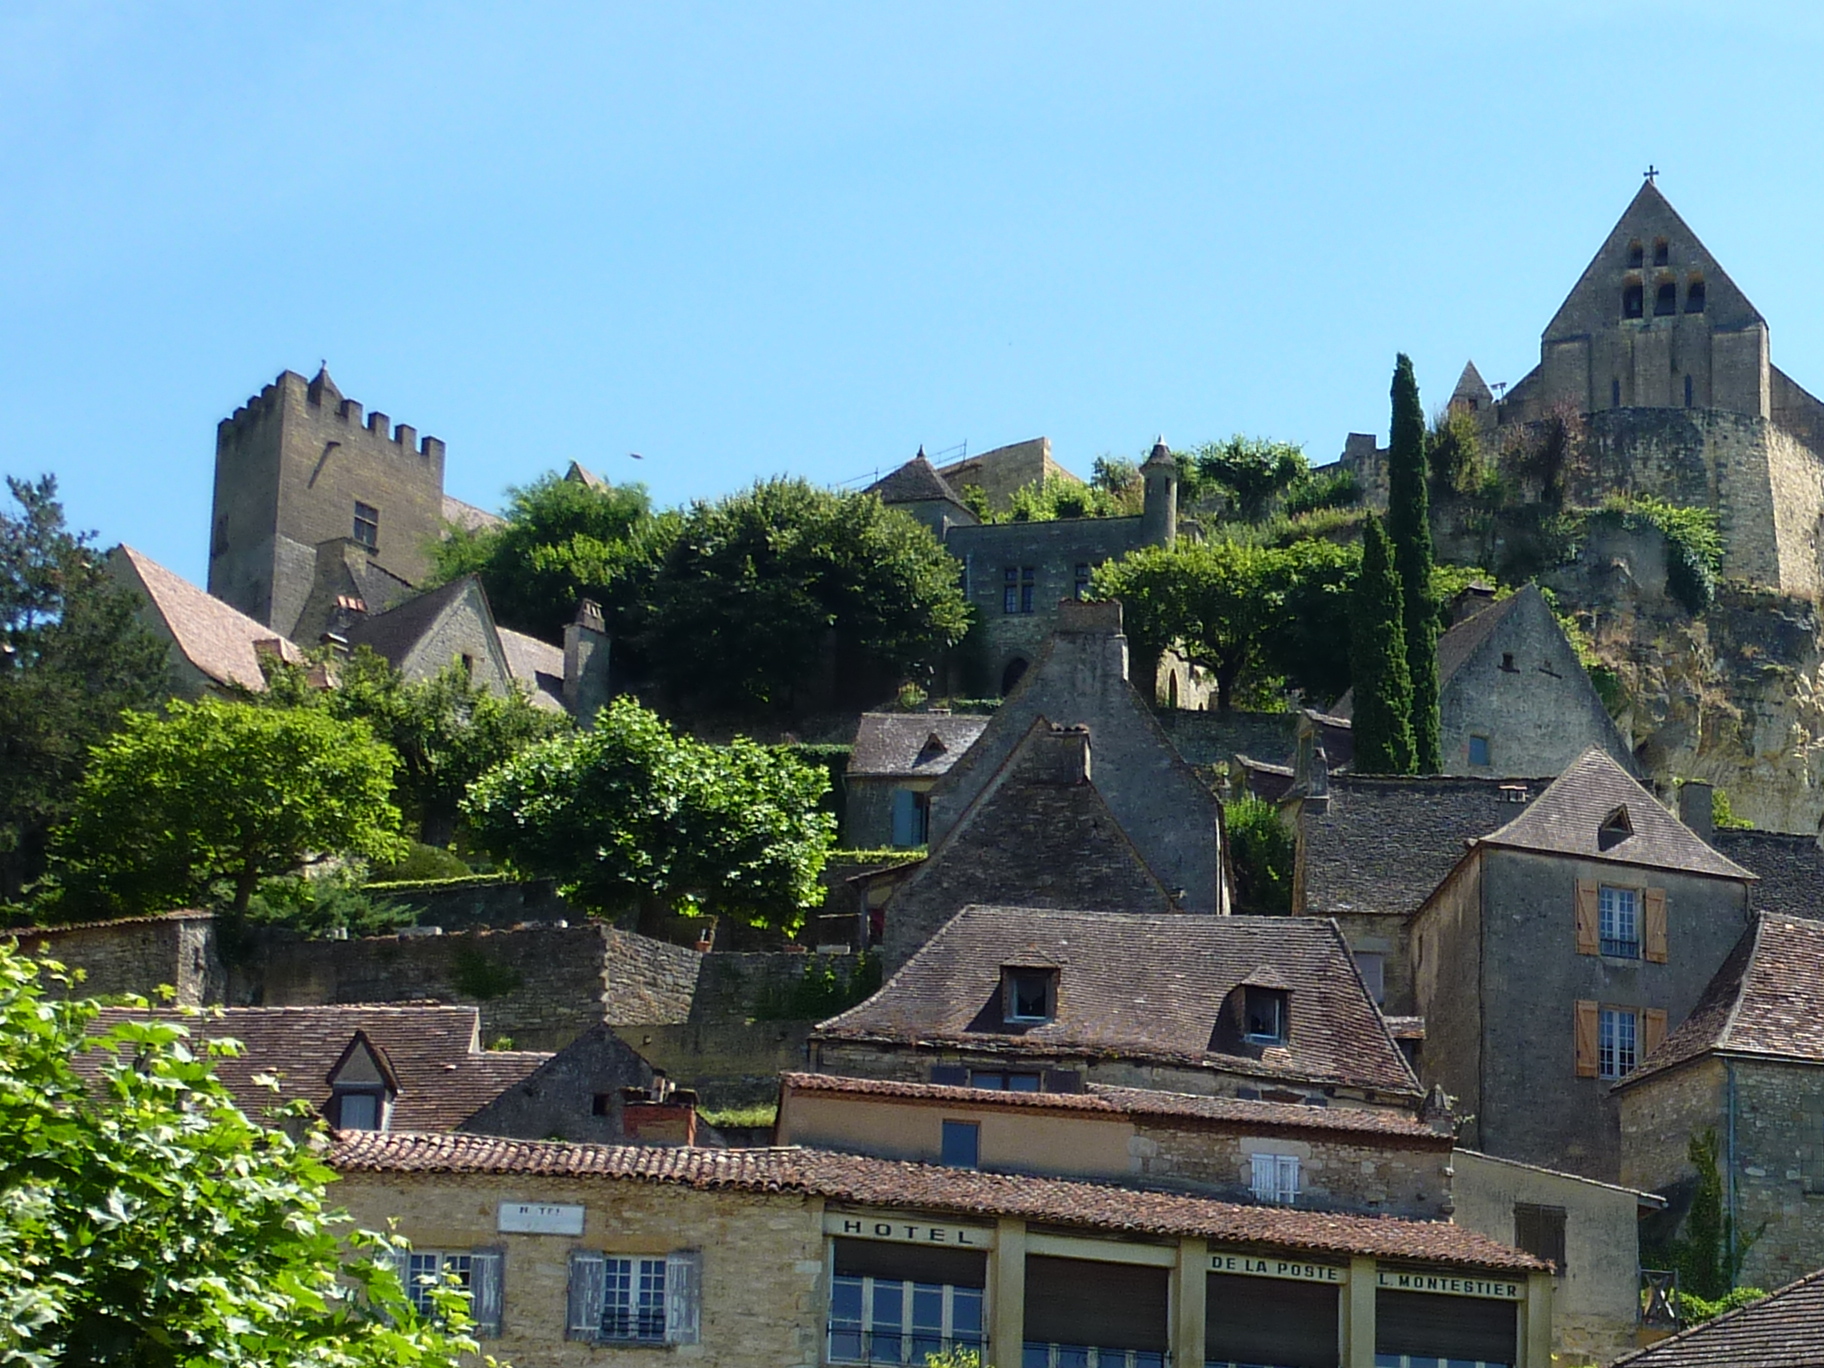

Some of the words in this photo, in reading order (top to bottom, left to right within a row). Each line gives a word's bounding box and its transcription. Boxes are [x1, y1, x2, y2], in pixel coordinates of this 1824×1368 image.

[844, 1220, 974, 1245] HOTEL
[1212, 1256, 1236, 1270] DE
[1245, 1259, 1268, 1273] LA
[1277, 1262, 1339, 1281] POSTE
[1399, 1275, 1517, 1297] MONTESTIER
